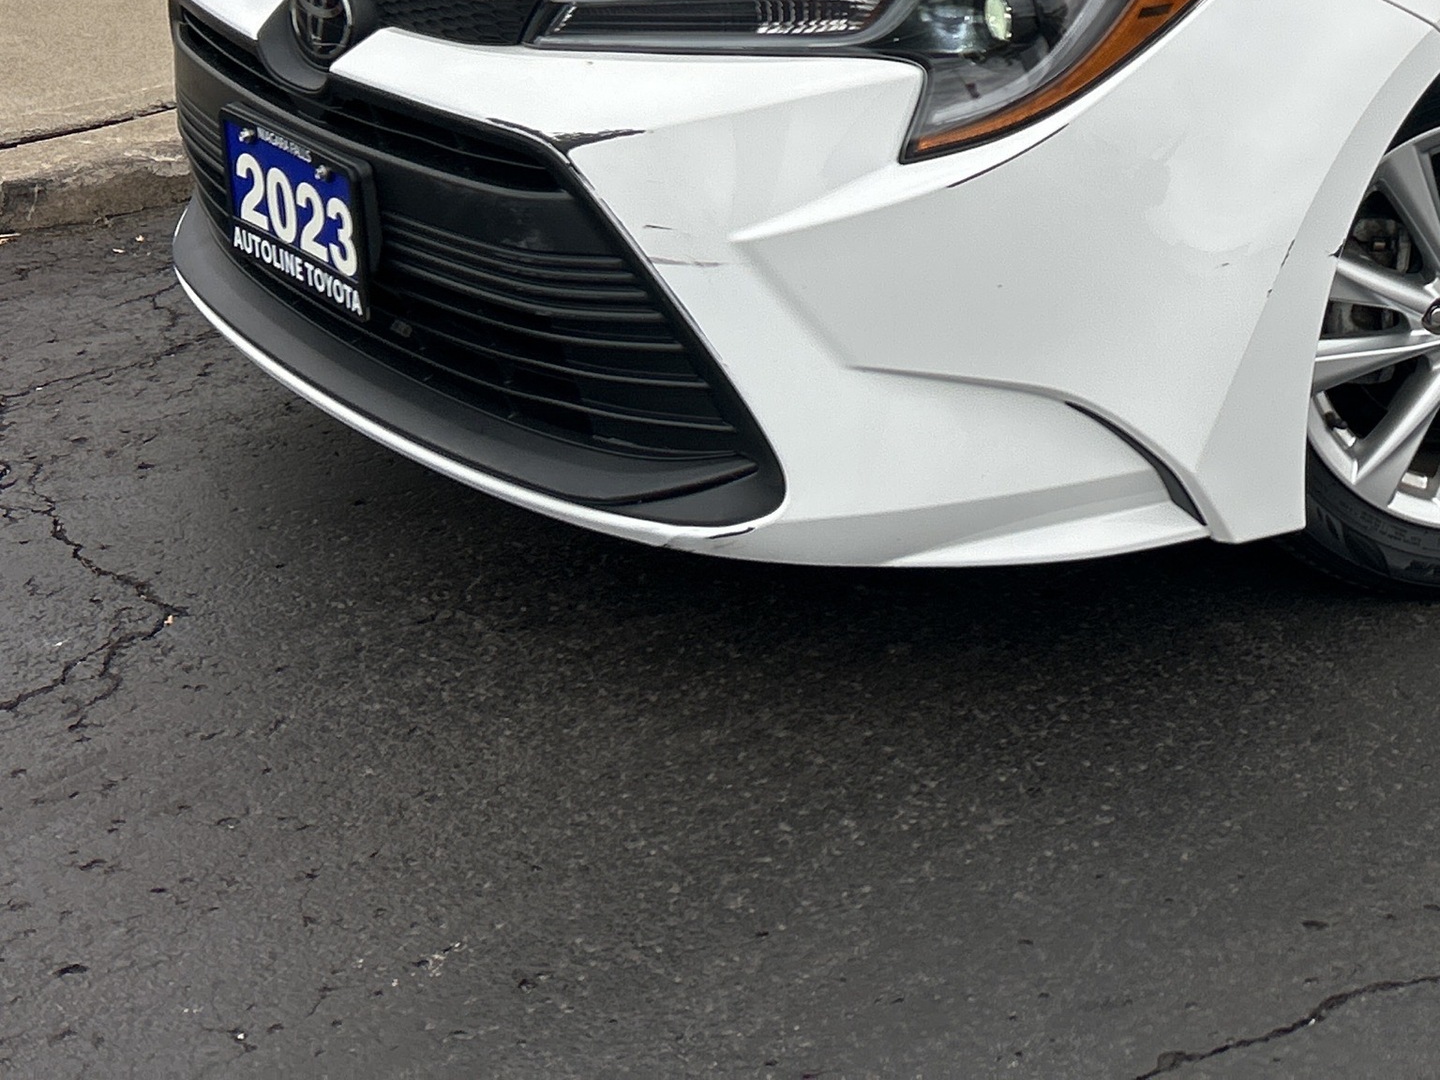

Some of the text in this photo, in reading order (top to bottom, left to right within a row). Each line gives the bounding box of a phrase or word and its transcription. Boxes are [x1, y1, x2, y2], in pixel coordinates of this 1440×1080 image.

[236, 153, 358, 277] 2023
[233, 226, 363, 316] AUTOLINE TOYOTA
